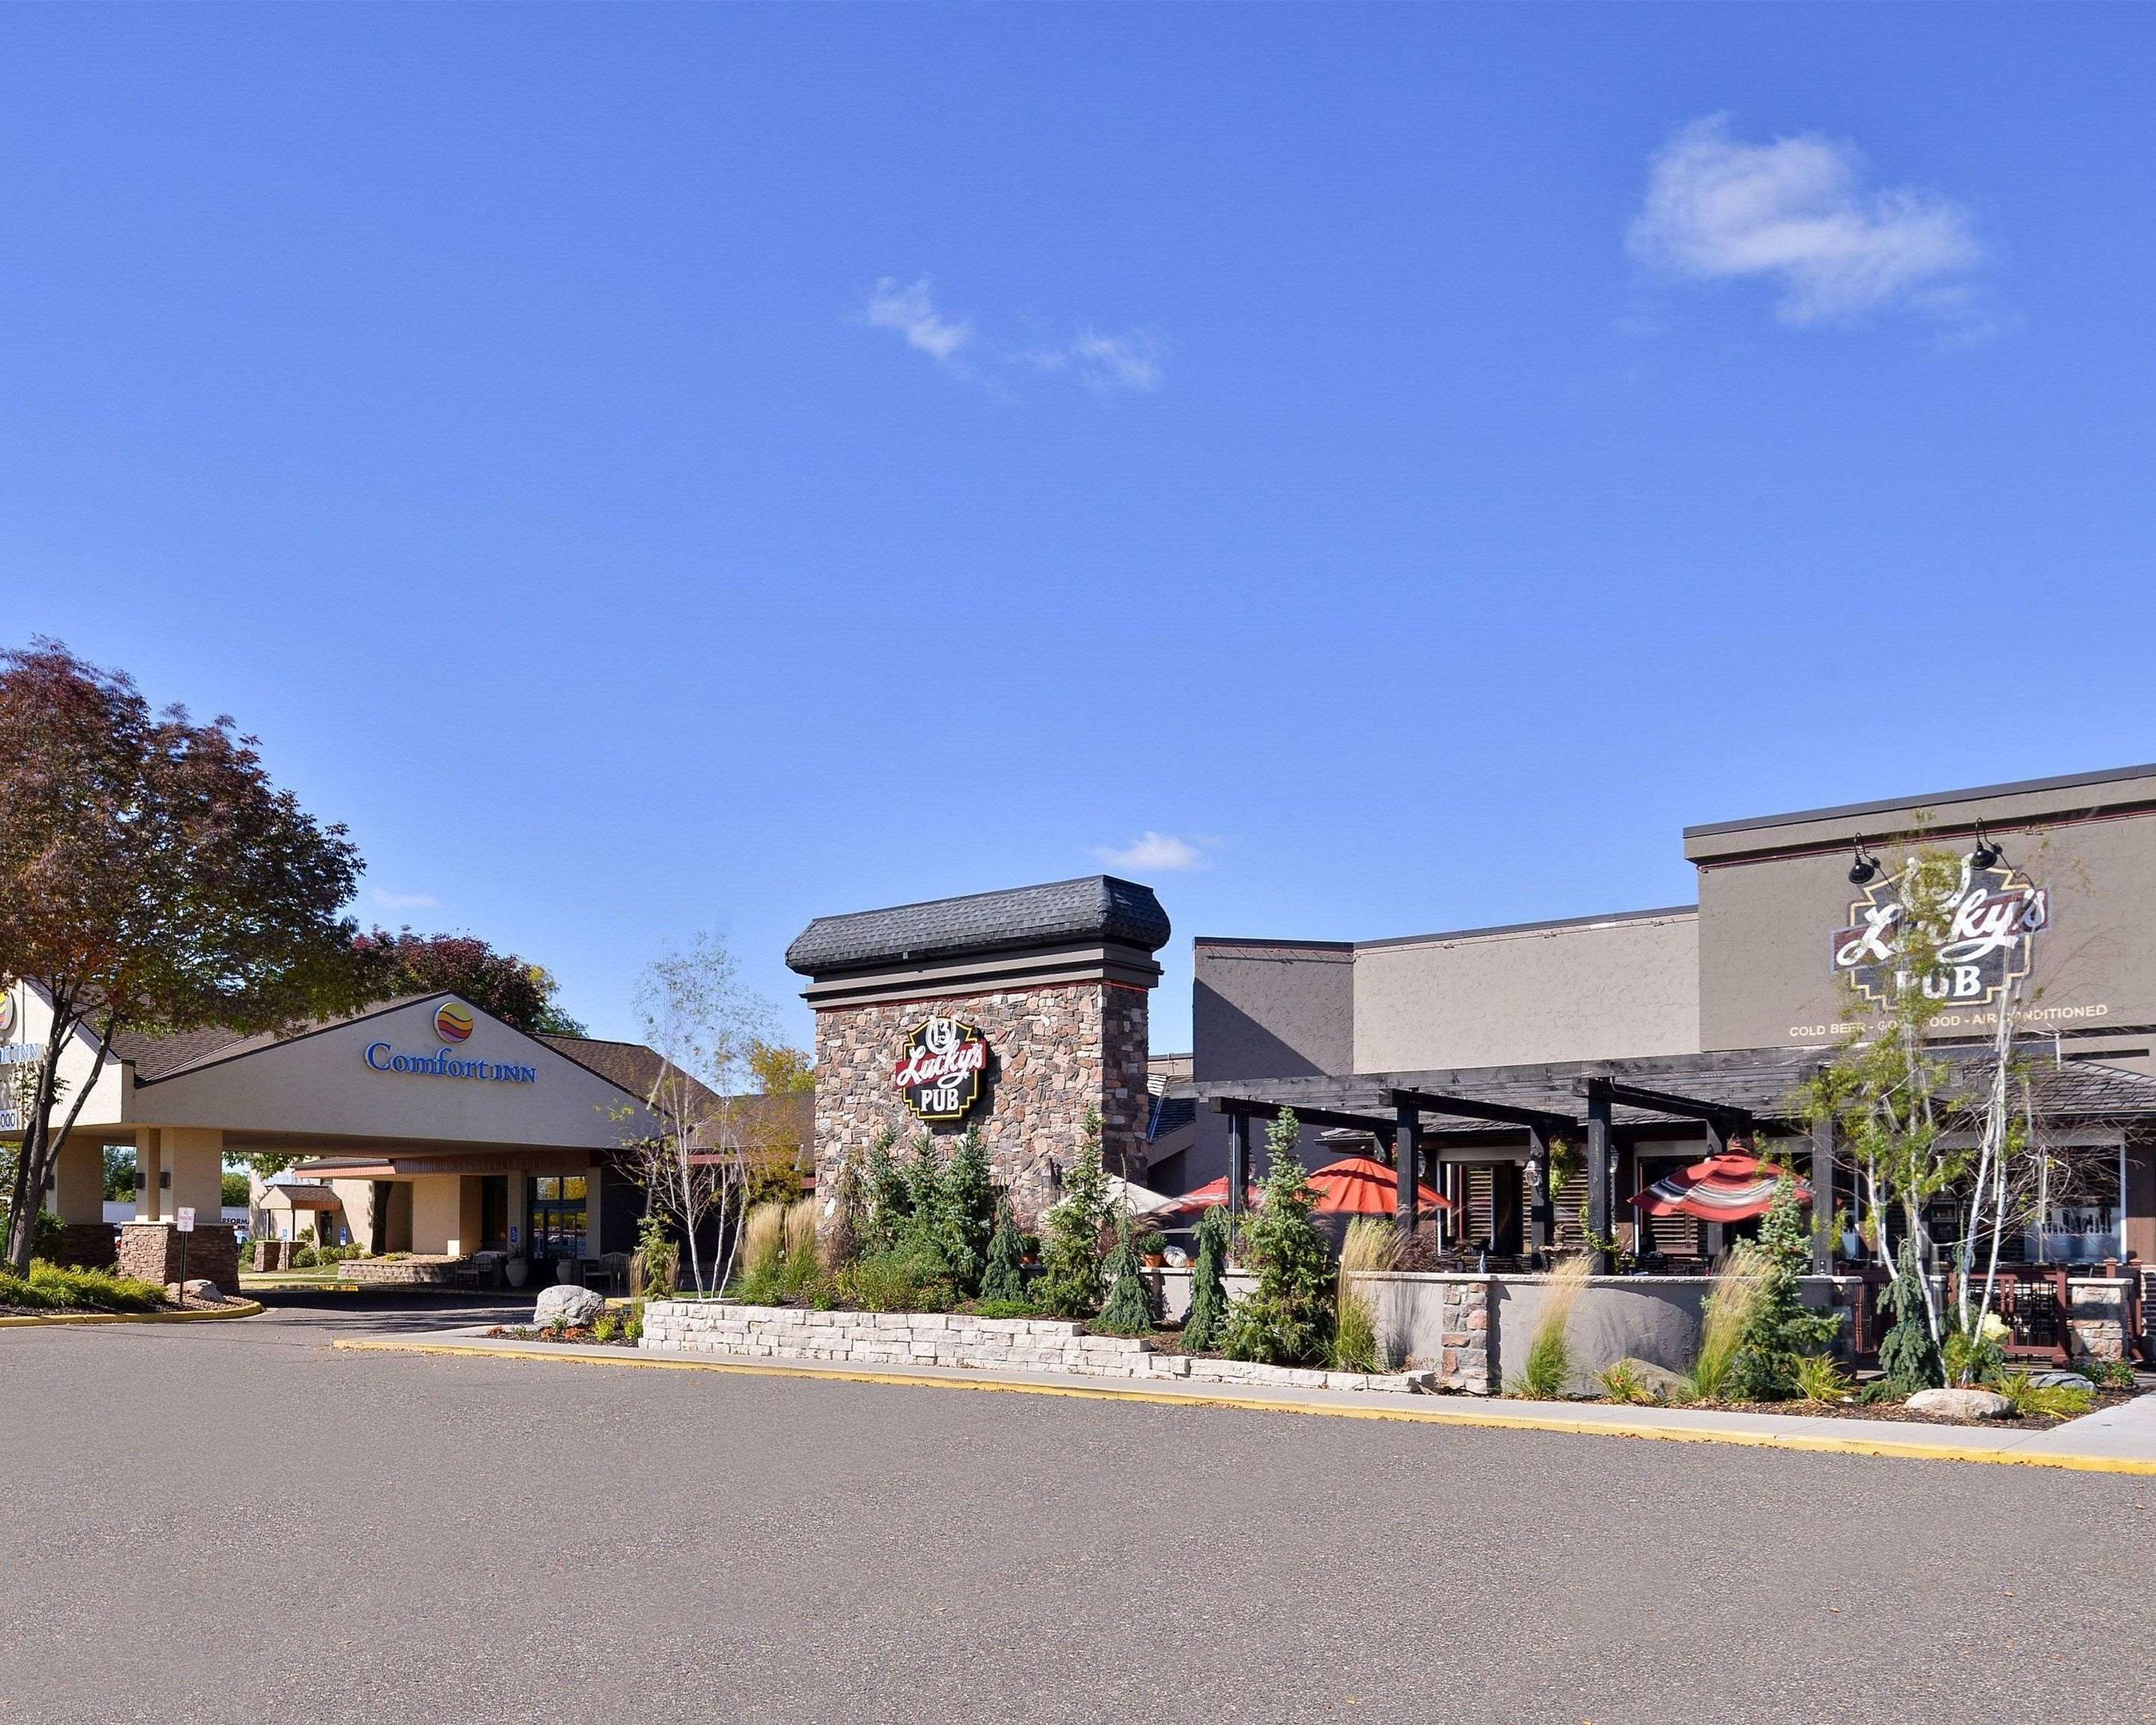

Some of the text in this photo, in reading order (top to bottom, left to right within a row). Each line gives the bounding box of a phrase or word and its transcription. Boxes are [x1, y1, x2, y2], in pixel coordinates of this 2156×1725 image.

[1789, 1025, 1826, 1037] COLD
[1830, 1022, 1866, 1034] BEER
[1921, 1016, 1960, 1028] OOD
[1972, 1013, 1997, 1025] AIR
[365, 1041, 537, 1084] Comfort INN
[896, 1039, 983, 1089] Lucky's
[920, 1088, 959, 1112] PUB
